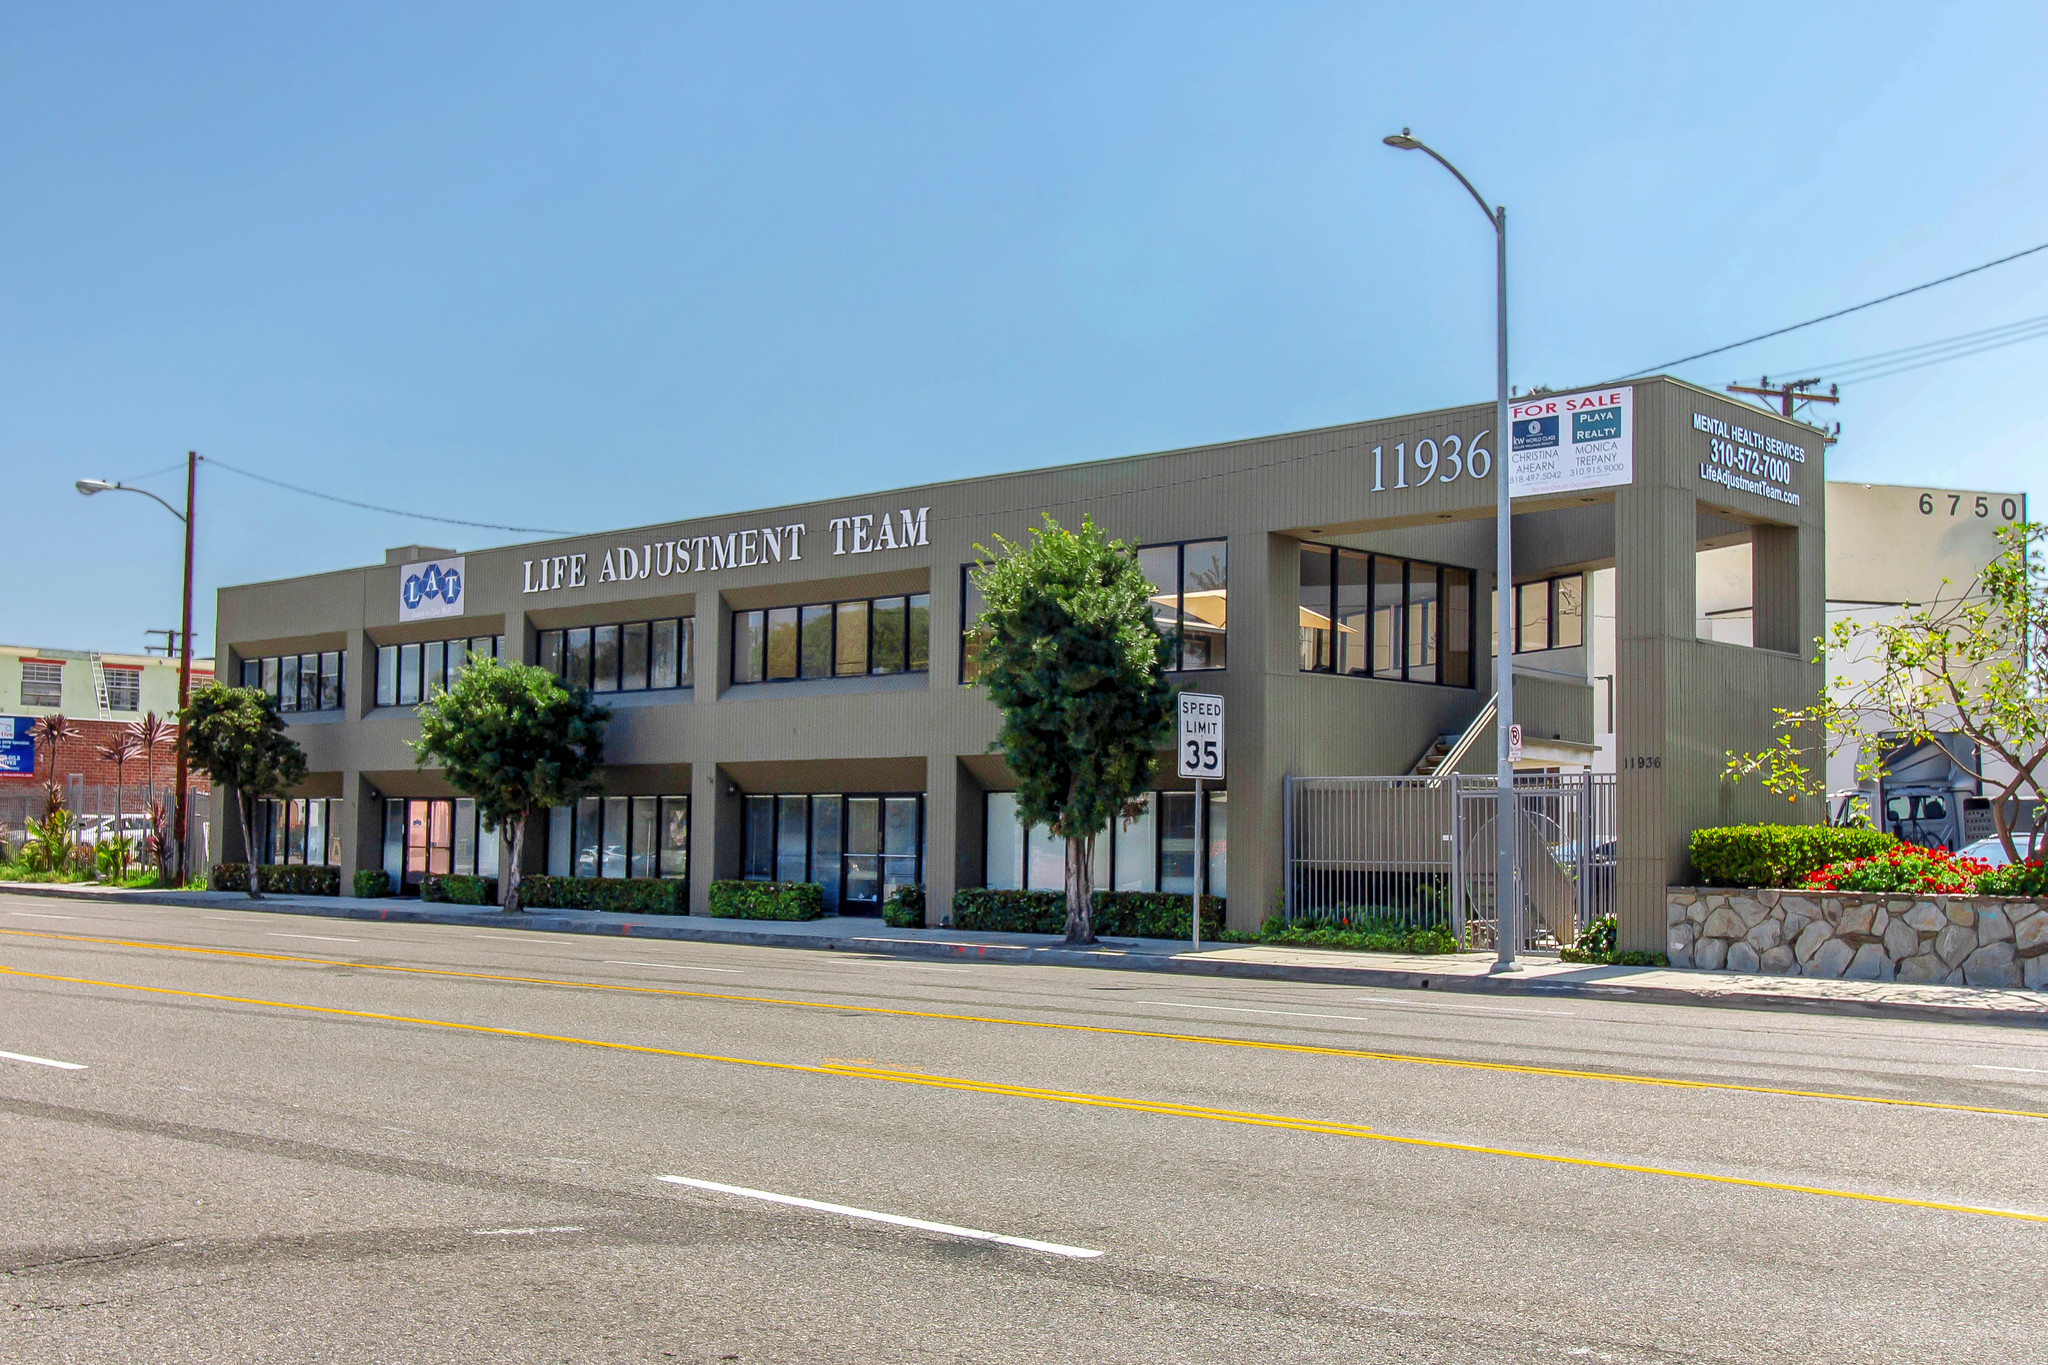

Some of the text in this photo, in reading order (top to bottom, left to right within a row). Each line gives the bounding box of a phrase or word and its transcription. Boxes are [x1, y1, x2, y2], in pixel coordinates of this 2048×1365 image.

[1513, 393, 1621, 418] FOR SALE
[1580, 411, 1613, 423] PLAYA
[1576, 427, 1616, 440] REALTY
[1693, 413, 1805, 464] MENTAL HEALTH SERVICES
[1575, 441, 1618, 455] MONICA
[1371, 429, 1491, 492] 11936
[1512, 449, 1559, 463] CHRISTINA
[1576, 453, 1617, 467] TREPANY
[1710, 438, 1791, 485] 310-572-7000
[1516, 461, 1555, 474] AHEARN
[1569, 463, 1624, 477] 310.915.9000
[1509, 471, 1561, 484] 818.497.5042
[1700, 462, 1800, 507] LifeAdjustmentTeam.com
[1919, 493, 2017, 521] 6750
[522, 506, 932, 593] LIFE ADJUSTMENT TEAM
[409, 570, 457, 602] LAT
[1182, 701, 1221, 716] SPEED
[1186, 720, 1217, 735] LIMIT
[1185, 740, 1218, 770] 35
[1624, 756, 1662, 769] 11936
